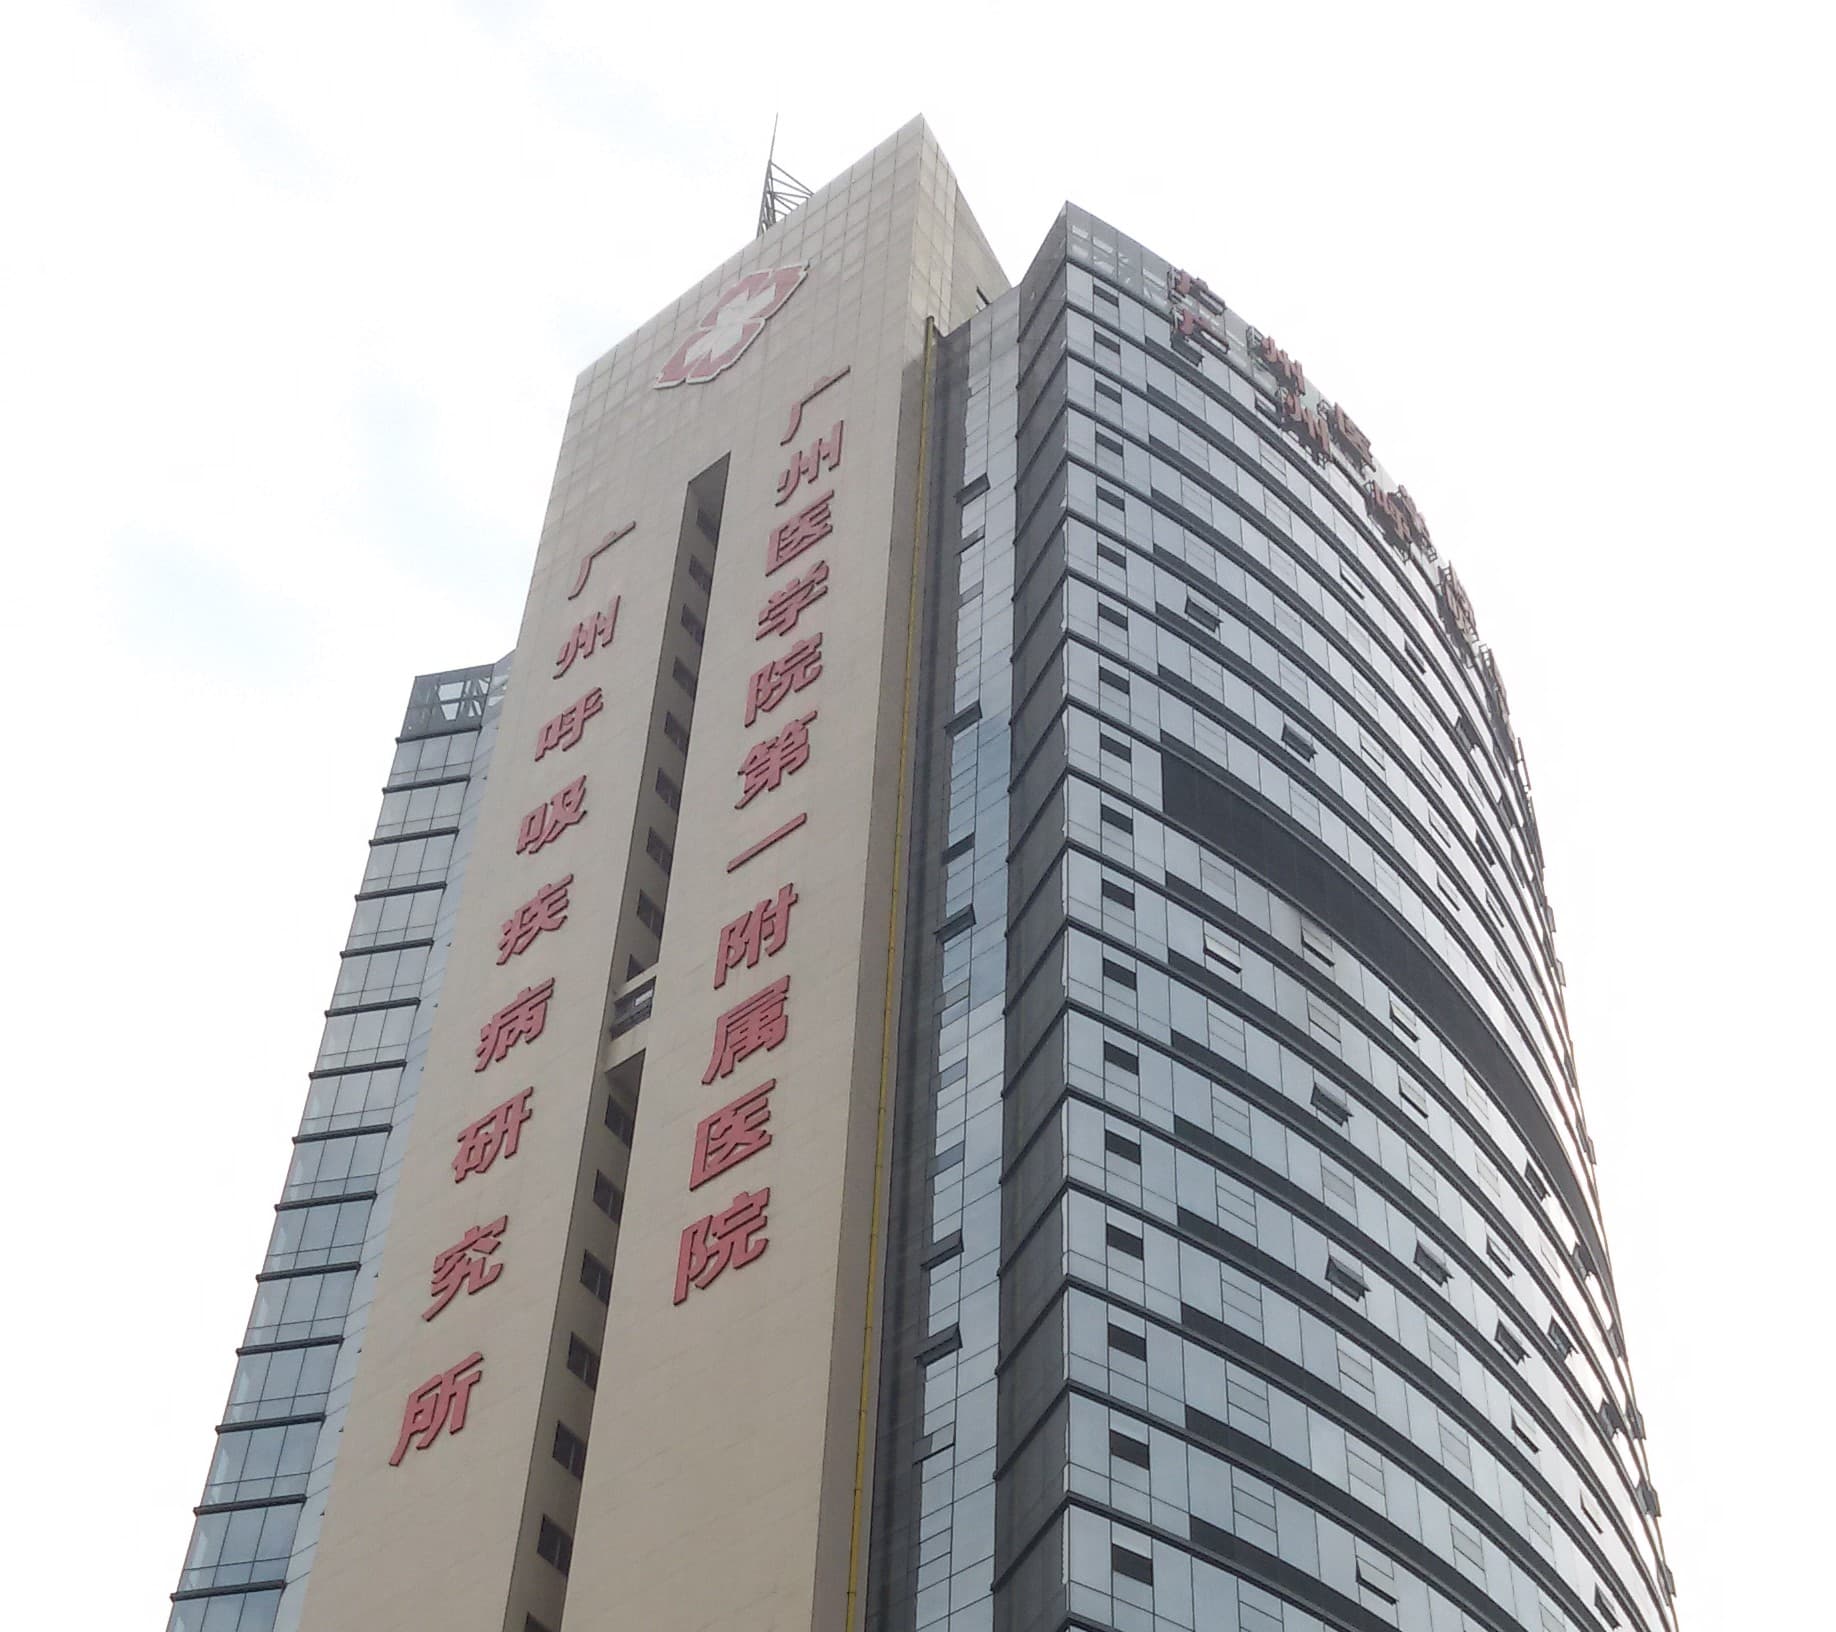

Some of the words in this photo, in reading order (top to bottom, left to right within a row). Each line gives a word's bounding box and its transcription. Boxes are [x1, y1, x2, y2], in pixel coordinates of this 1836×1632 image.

[388, 521, 637, 1466] 广州呼吸疾病研究所
[672, 366, 851, 1306] 广州医学院第一附属医院
